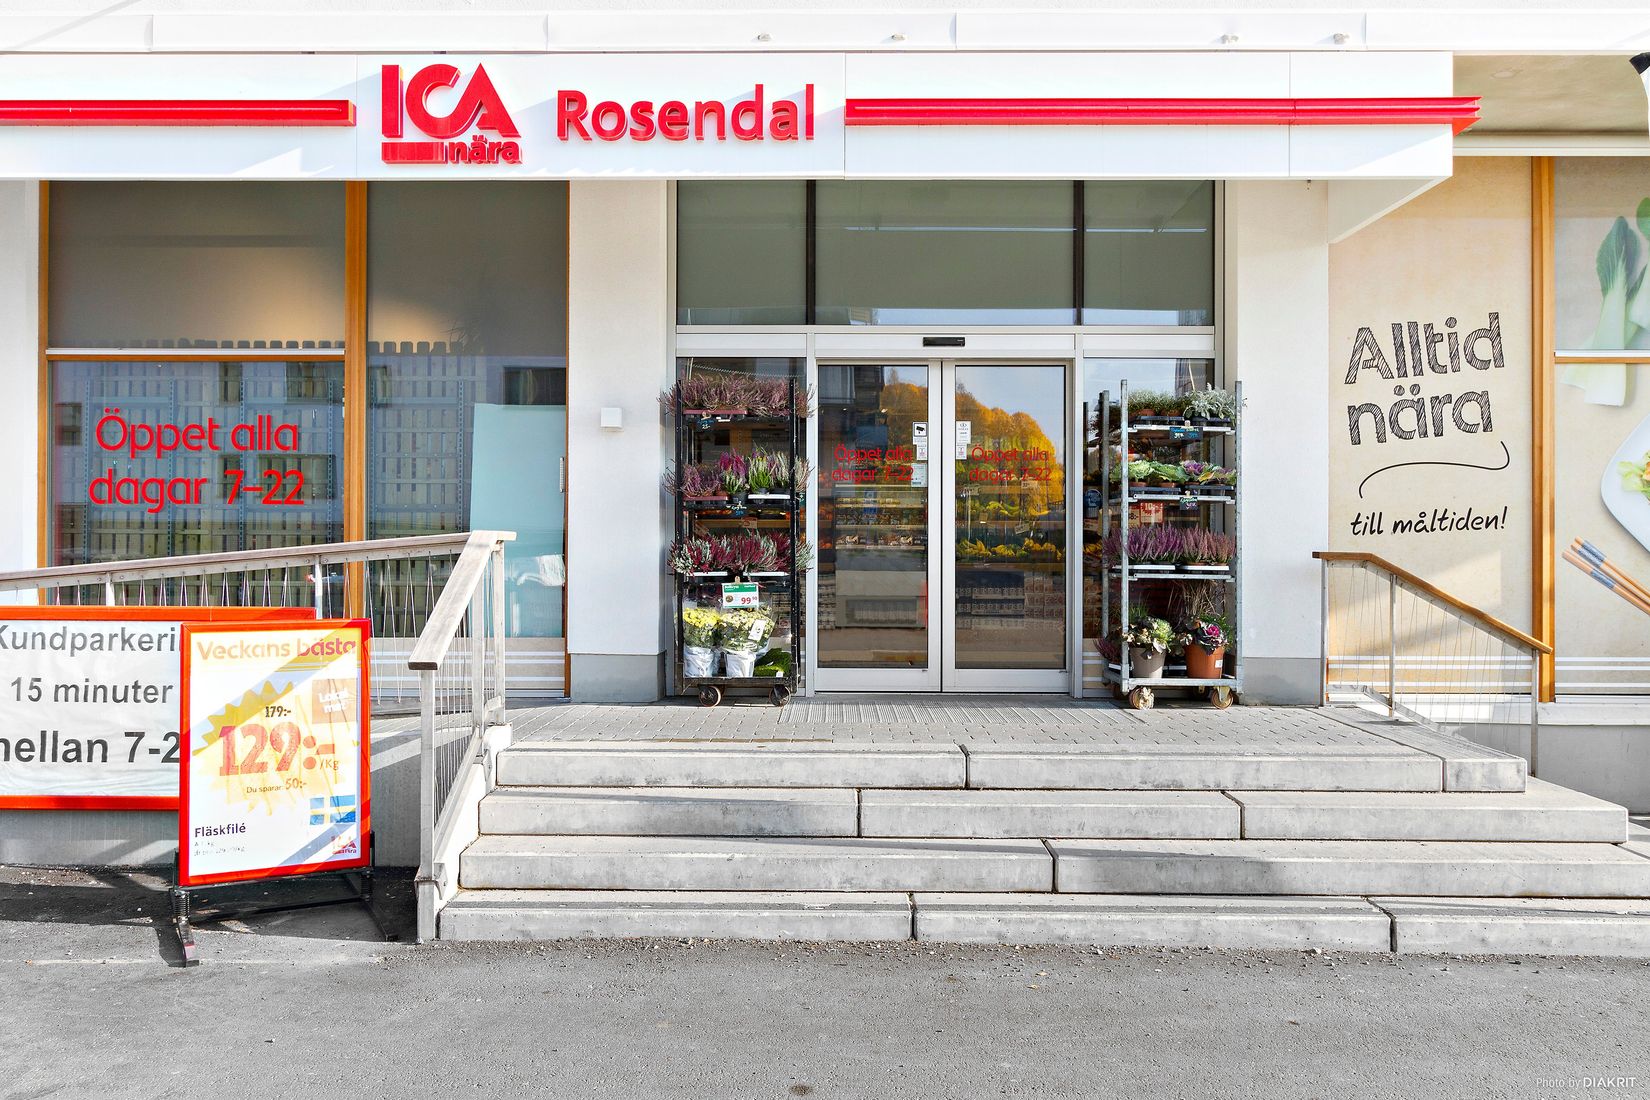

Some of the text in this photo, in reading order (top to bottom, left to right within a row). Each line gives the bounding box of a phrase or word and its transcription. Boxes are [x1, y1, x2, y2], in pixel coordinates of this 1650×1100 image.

[381, 63, 521, 139] ICA
[557, 83, 815, 141] Rosendal
[447, 134, 522, 164] nära
[1344, 311, 1505, 385] Alltid
[1347, 383, 1493, 446] nära
[95, 407, 299, 459] Öppet alla
[833, 443, 883, 465] Öppet
[885, 445, 914, 461] alla
[971, 443, 1019, 464] Öppet
[1022, 446, 1050, 461] alla
[831, 465, 877, 485] dagar
[969, 467, 1015, 485] dagar
[88, 468, 208, 514] dagar
[1350, 506, 1508, 536] till måltiden!
[196, 638, 357, 661] Veckans bästa
[11, 677, 174, 703] 15 minuter
[265, 705, 291, 718] 179:-
[219, 722, 335, 776] 129:-
[285, 777, 307, 790] 50:-
[195, 822, 246, 838] Fläskfilé
